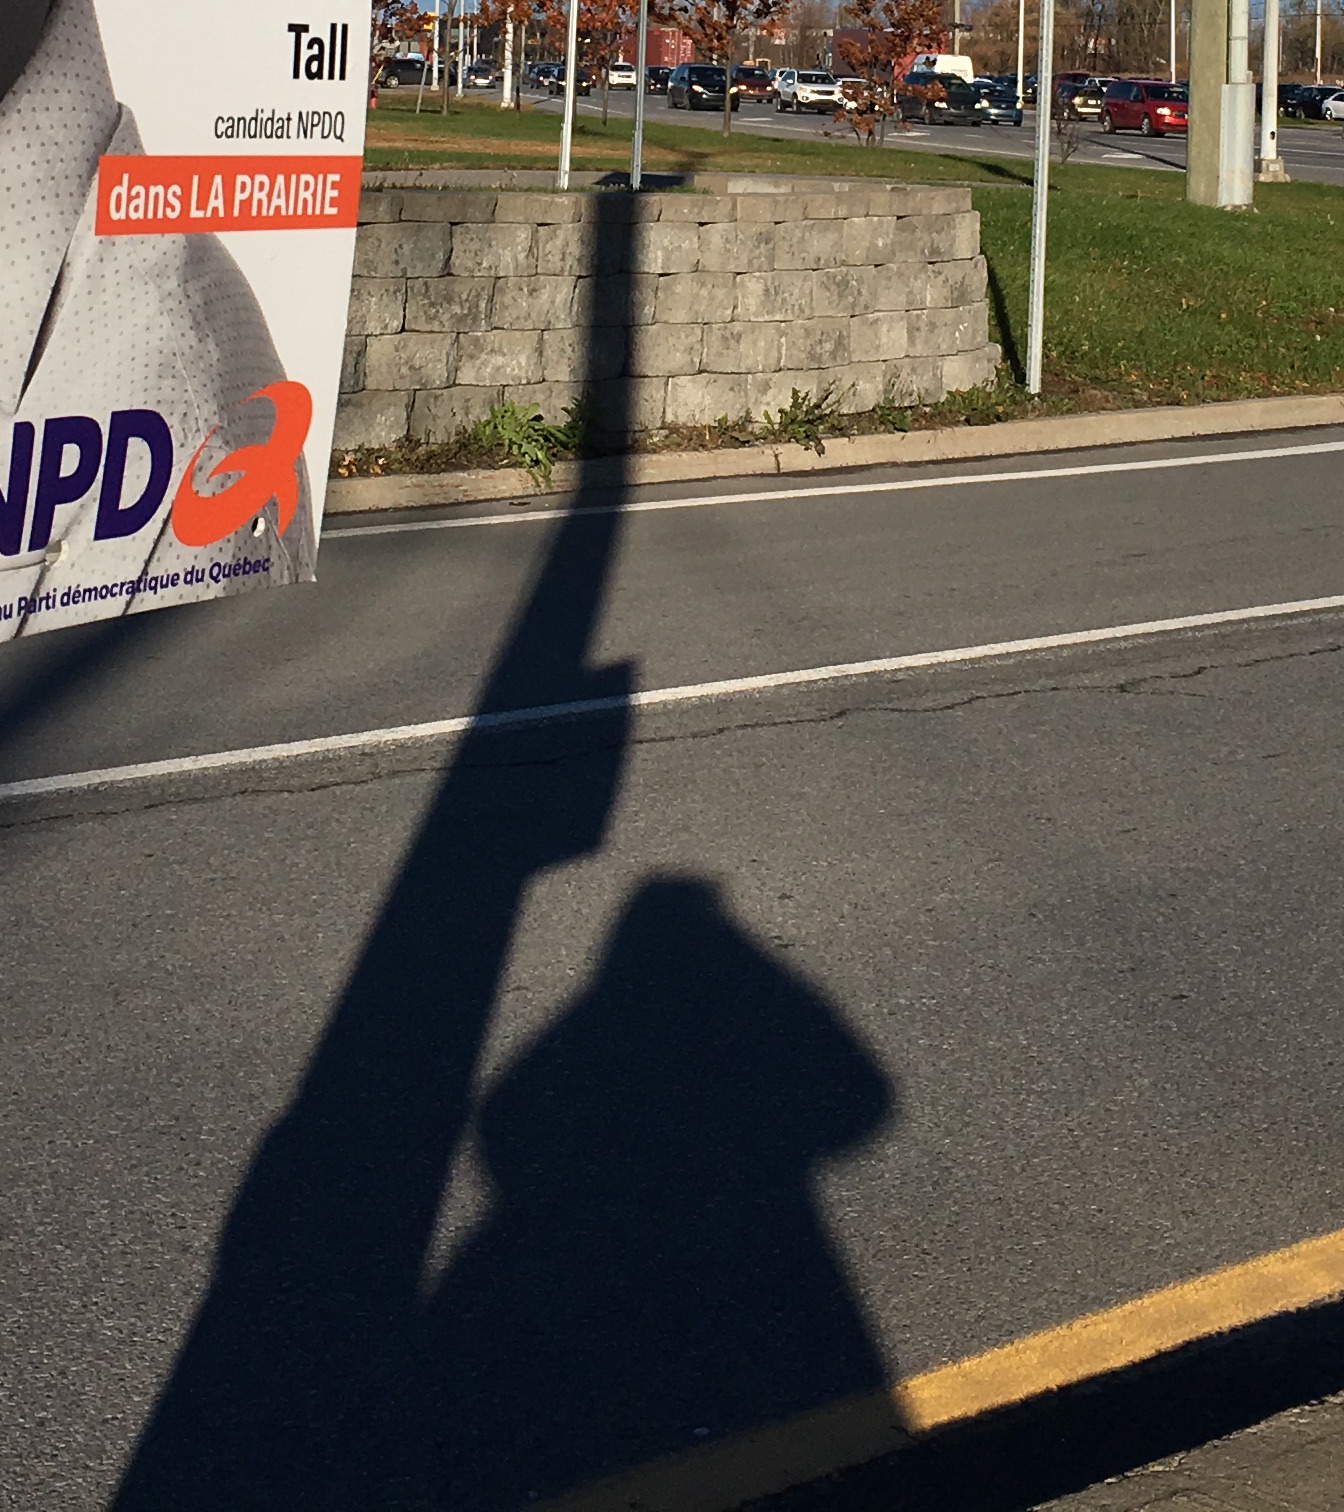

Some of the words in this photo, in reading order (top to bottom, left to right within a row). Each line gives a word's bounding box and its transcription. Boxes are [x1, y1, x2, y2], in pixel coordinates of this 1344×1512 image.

[287, 23, 349, 81] Tall
[214, 108, 292, 140] candidat
[297, 110, 346, 143] NPDQ
[109, 172, 182, 221] dans
[189, 174, 225, 218] LA
[233, 173, 341, 218] PRAIRIE
[17, 590, 57, 615] Parti
[59, 571, 180, 608] démocratique
[183, 565, 206, 586] du
[208, 555, 271, 584] Québec
